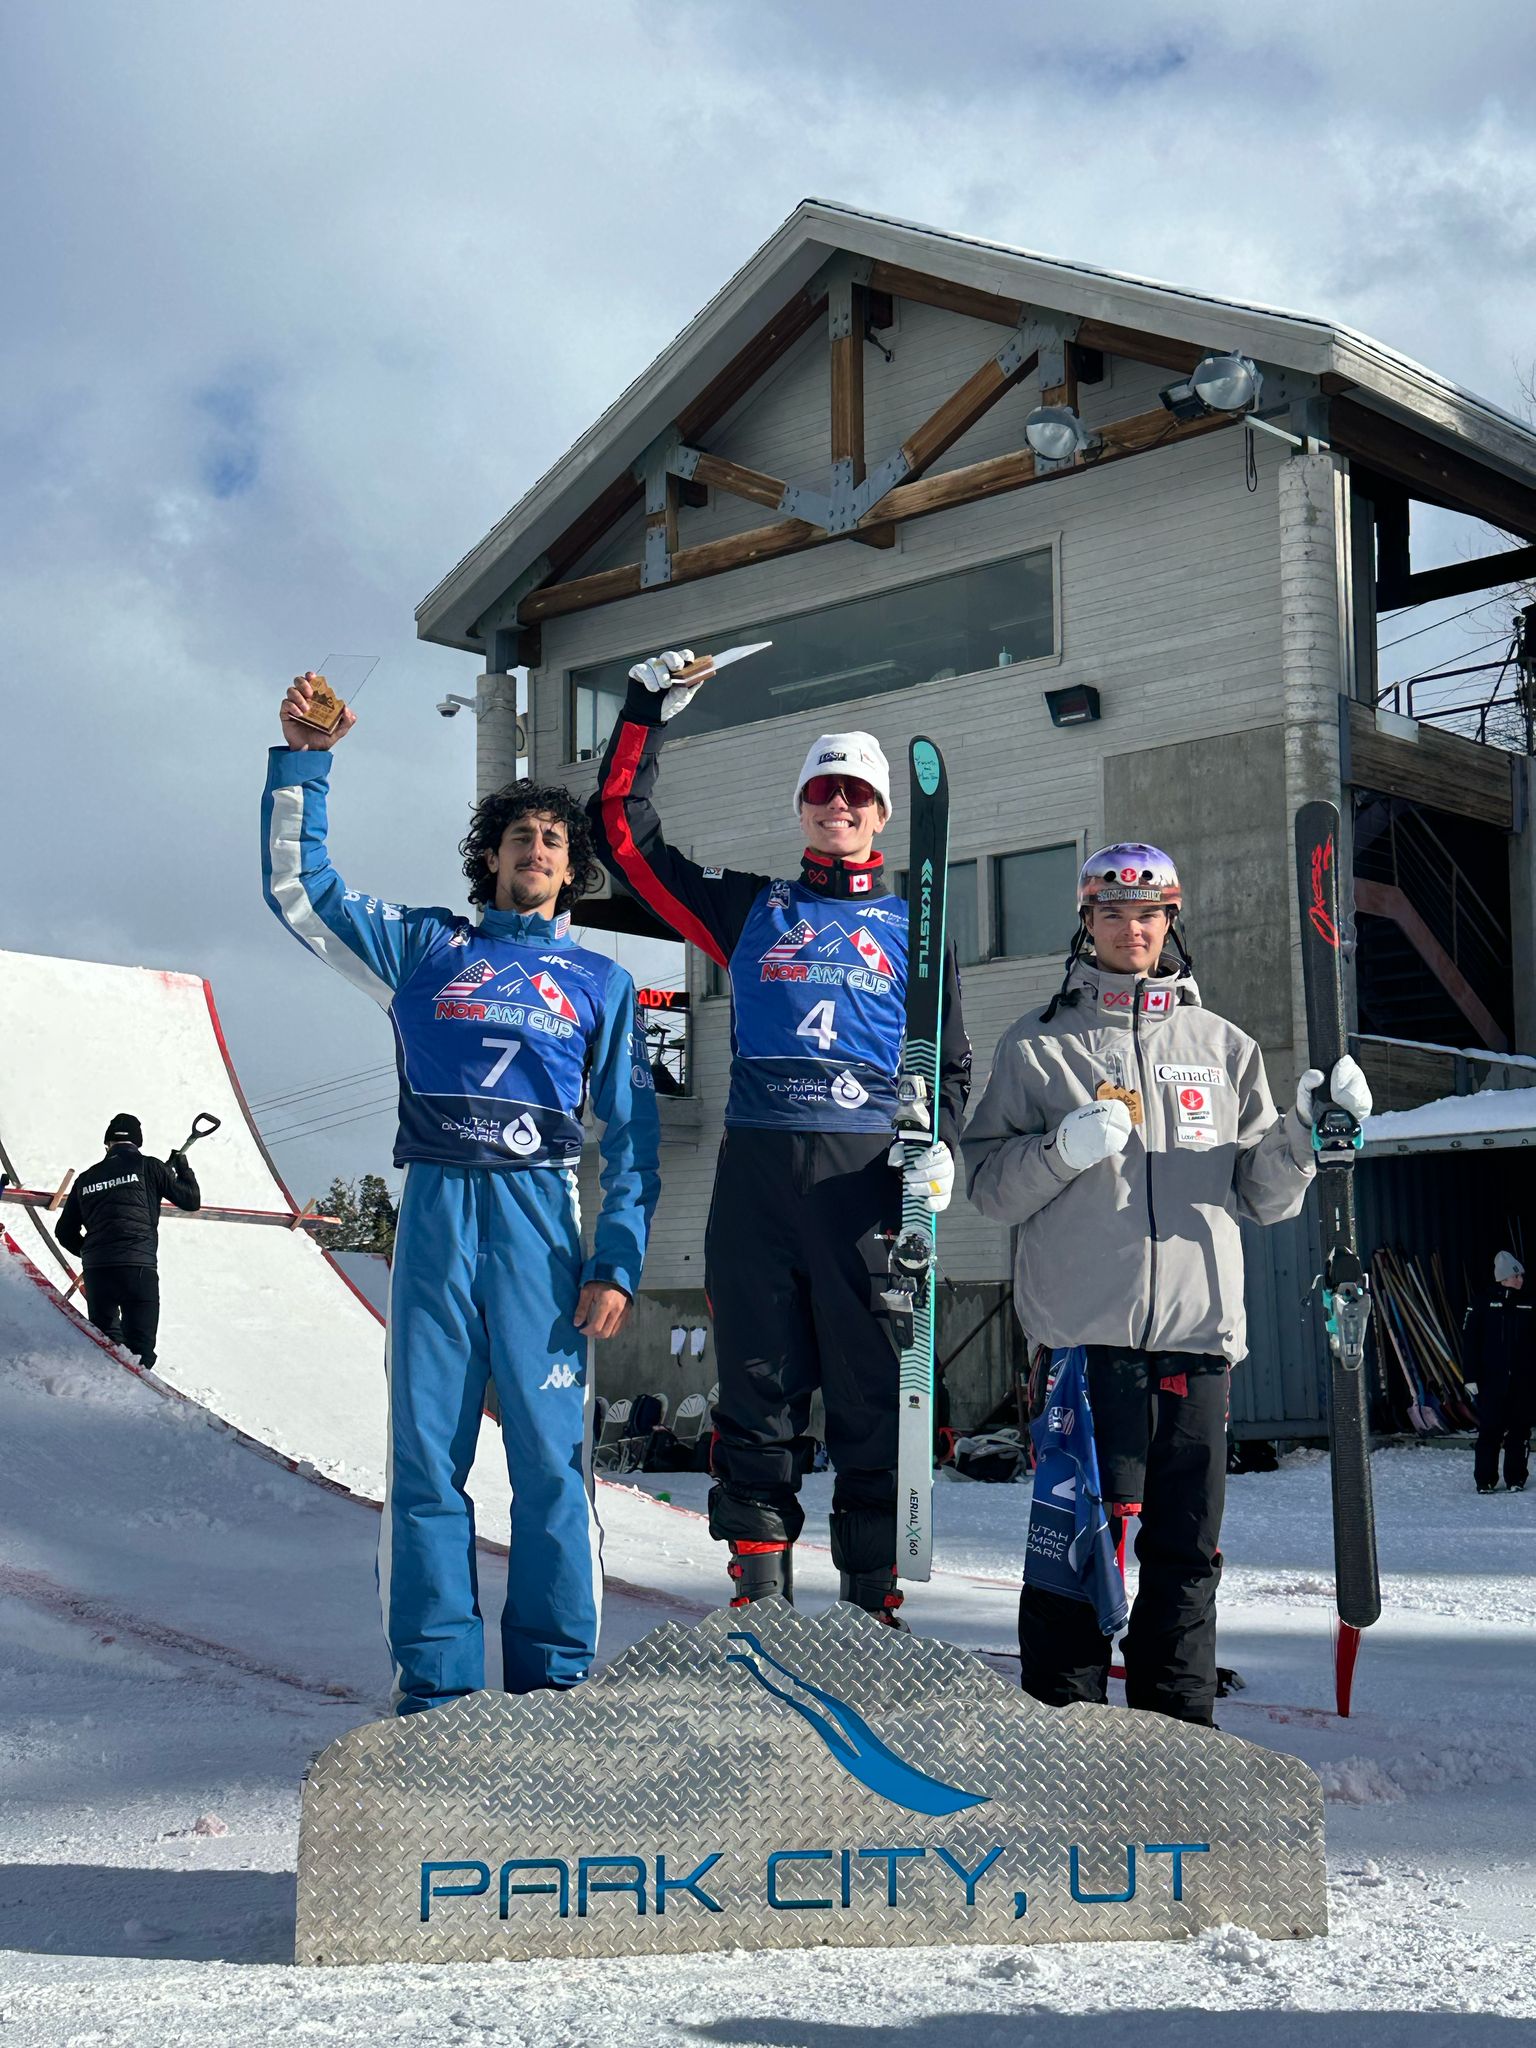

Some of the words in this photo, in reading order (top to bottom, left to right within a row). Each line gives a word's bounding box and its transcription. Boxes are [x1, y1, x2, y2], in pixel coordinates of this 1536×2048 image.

[847, 970, 891, 996] CUP
[638, 988, 675, 1007] ADY
[527, 1010, 575, 1039] CUP
[796, 1000, 838, 1050] 4
[480, 1037, 521, 1088] 7
[788, 1077, 827, 1086] UTAH
[1158, 1066, 1221, 1084] Canada
[766, 1083, 828, 1094] OLYMPIC
[788, 1093, 827, 1102] PARK
[441, 1123, 500, 1136] OLYMPIC
[462, 1116, 500, 1129] UTAH
[459, 1132, 499, 1144] PARK
[82, 1173, 139, 1196] AUSTRALIA
[1030, 1523, 1069, 1542] UTAH
[420, 1852, 724, 1922] PARK
[766, 1845, 1027, 1920] CITY,
[1069, 1843, 1210, 1904] UT
